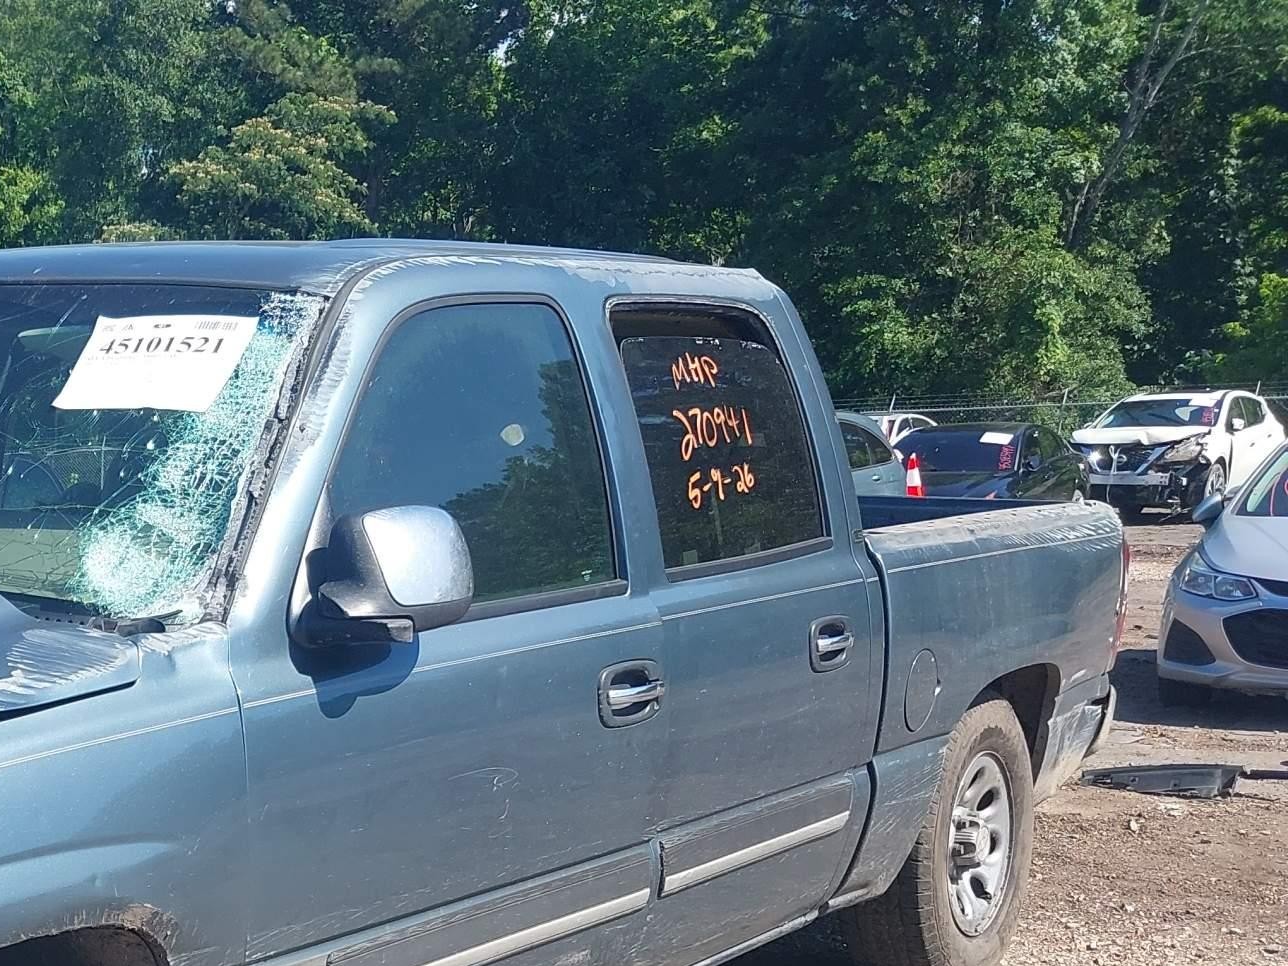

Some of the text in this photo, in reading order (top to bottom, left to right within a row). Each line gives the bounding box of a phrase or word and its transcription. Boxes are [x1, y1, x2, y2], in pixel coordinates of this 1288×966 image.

[99, 336, 224, 355] 45101521
[672, 404, 753, 461] 270941
[687, 464, 756, 510] 5-9-26
